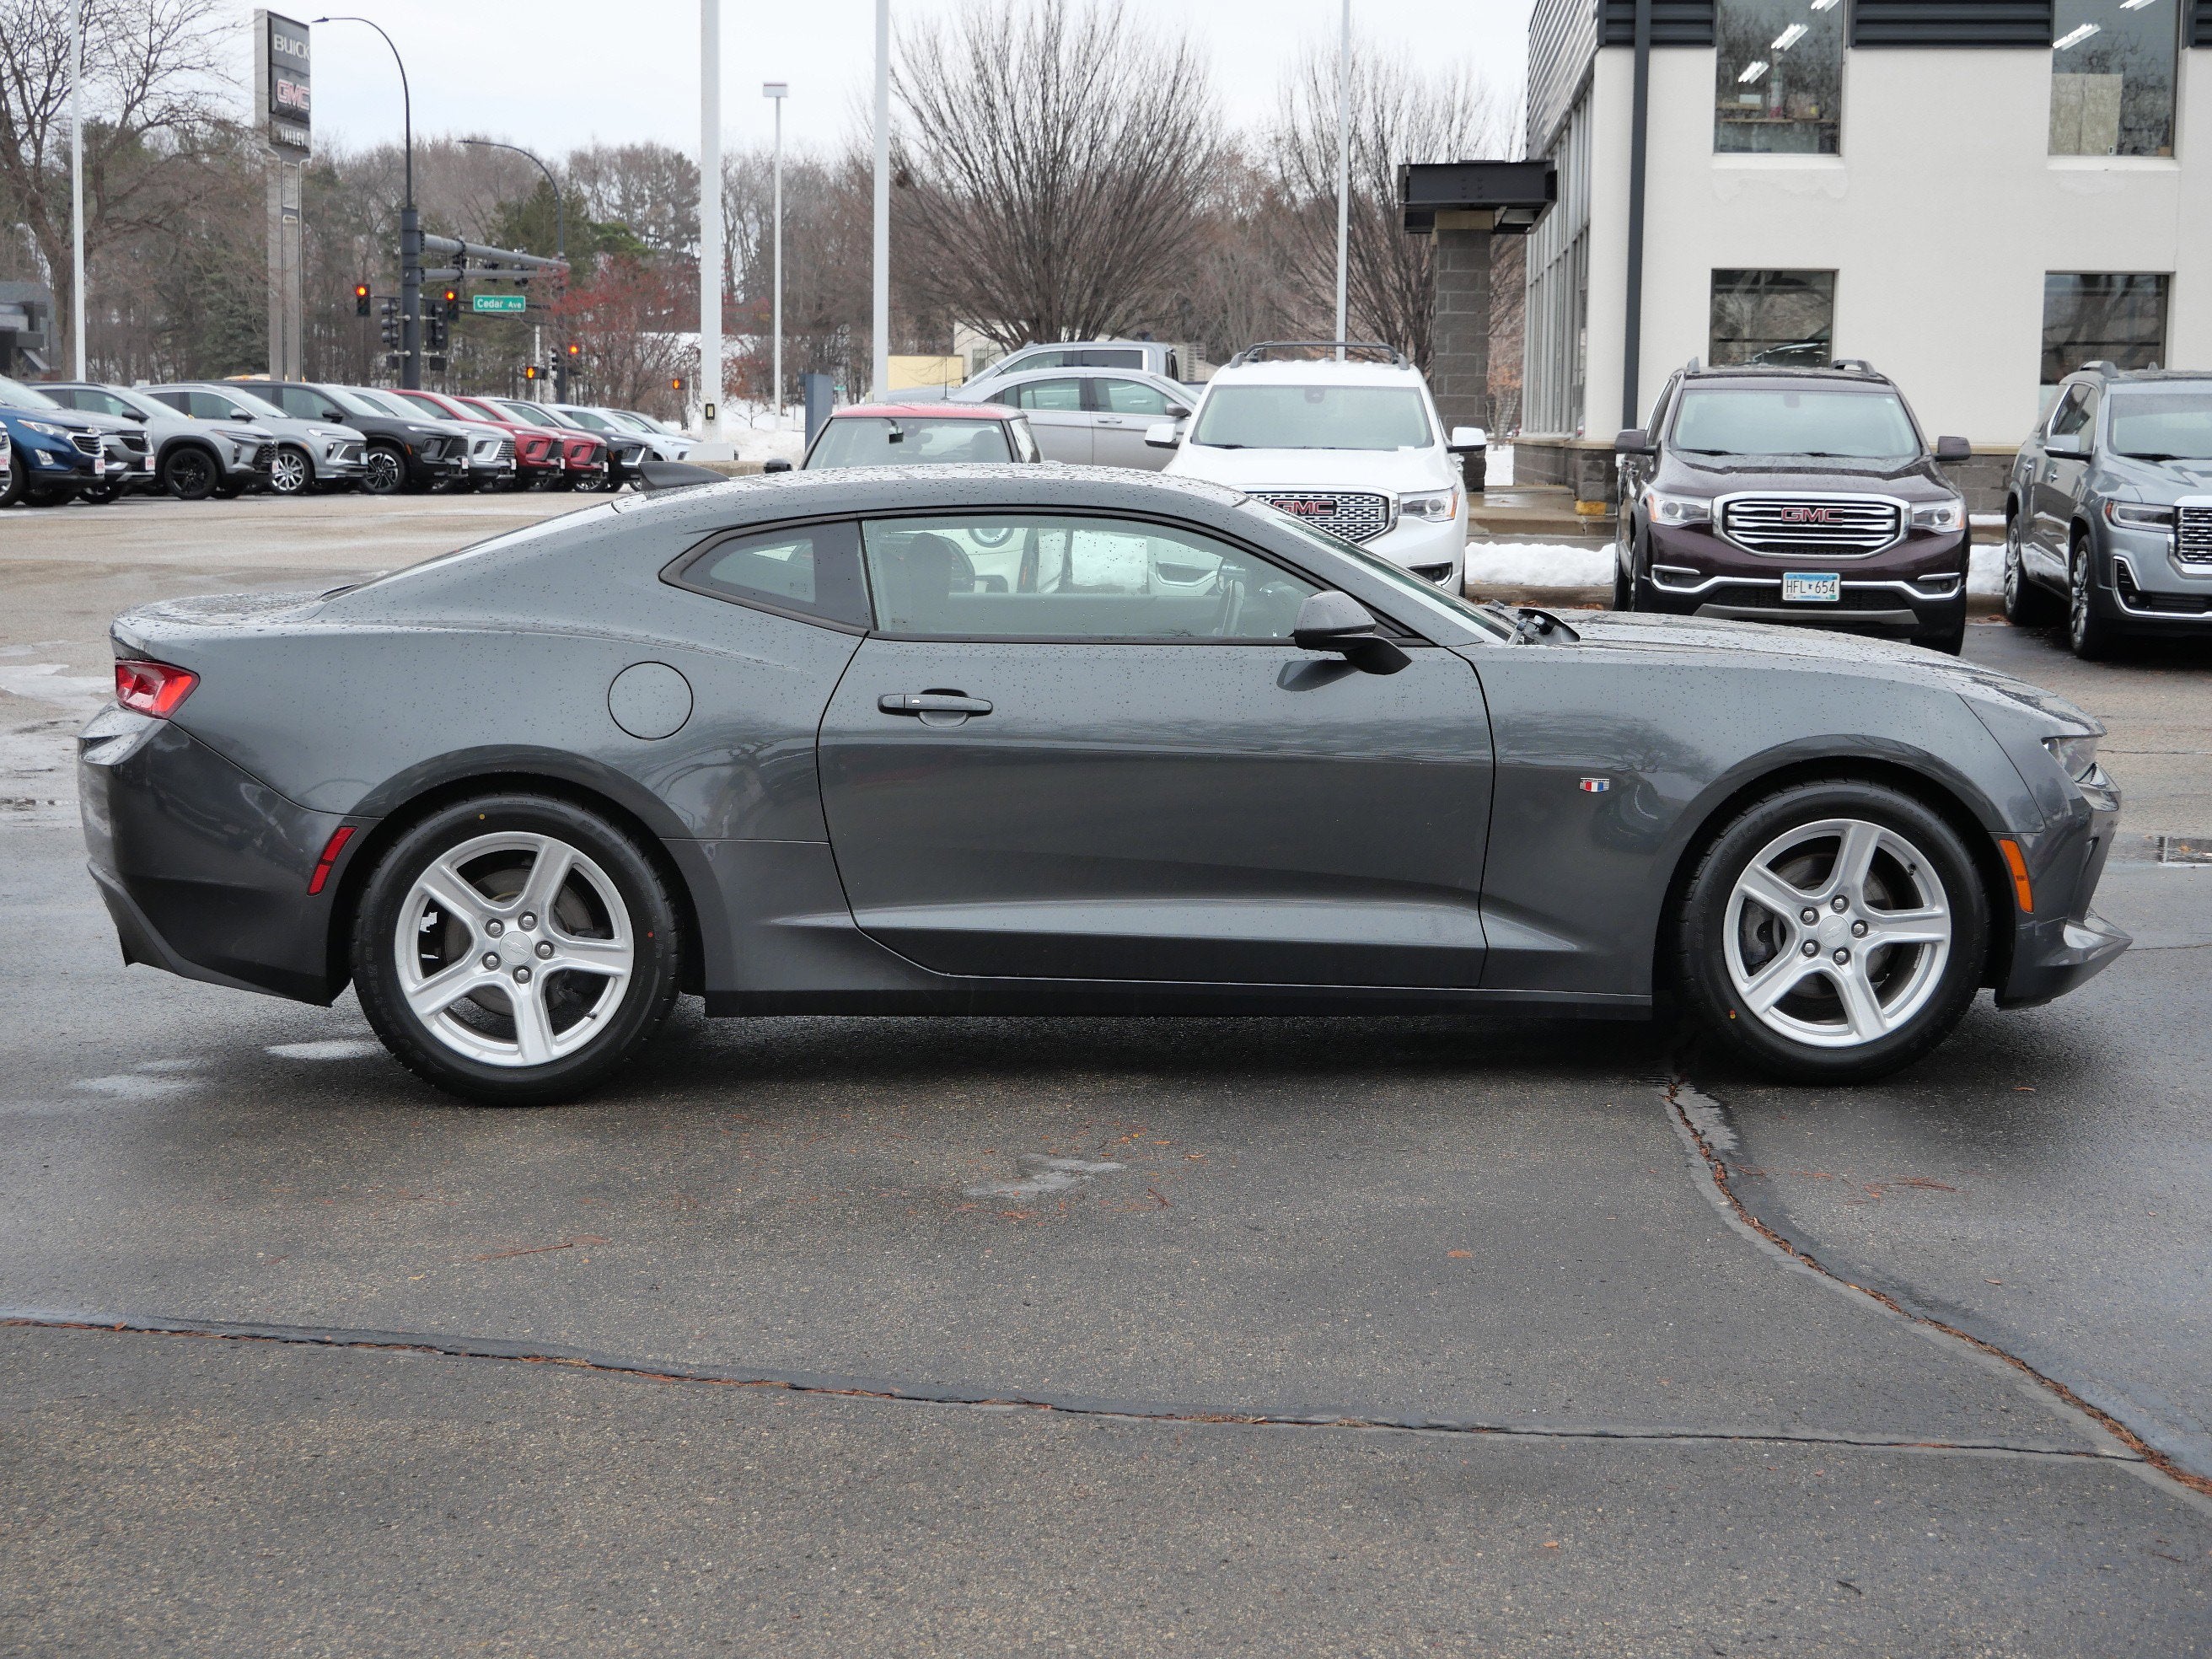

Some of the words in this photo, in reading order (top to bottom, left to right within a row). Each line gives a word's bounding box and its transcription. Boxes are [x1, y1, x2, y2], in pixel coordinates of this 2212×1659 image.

[273, 34, 310, 62] BUICK
[276, 78, 310, 110] GMC
[280, 127, 305, 147] VALLEY
[477, 298, 503, 309] Cedar
[507, 301, 522, 309] Ave
[1274, 501, 1334, 515] GMC
[1781, 507, 1844, 523] GMC
[1786, 581, 1807, 593] HFL
[1815, 581, 1835, 593] 654
